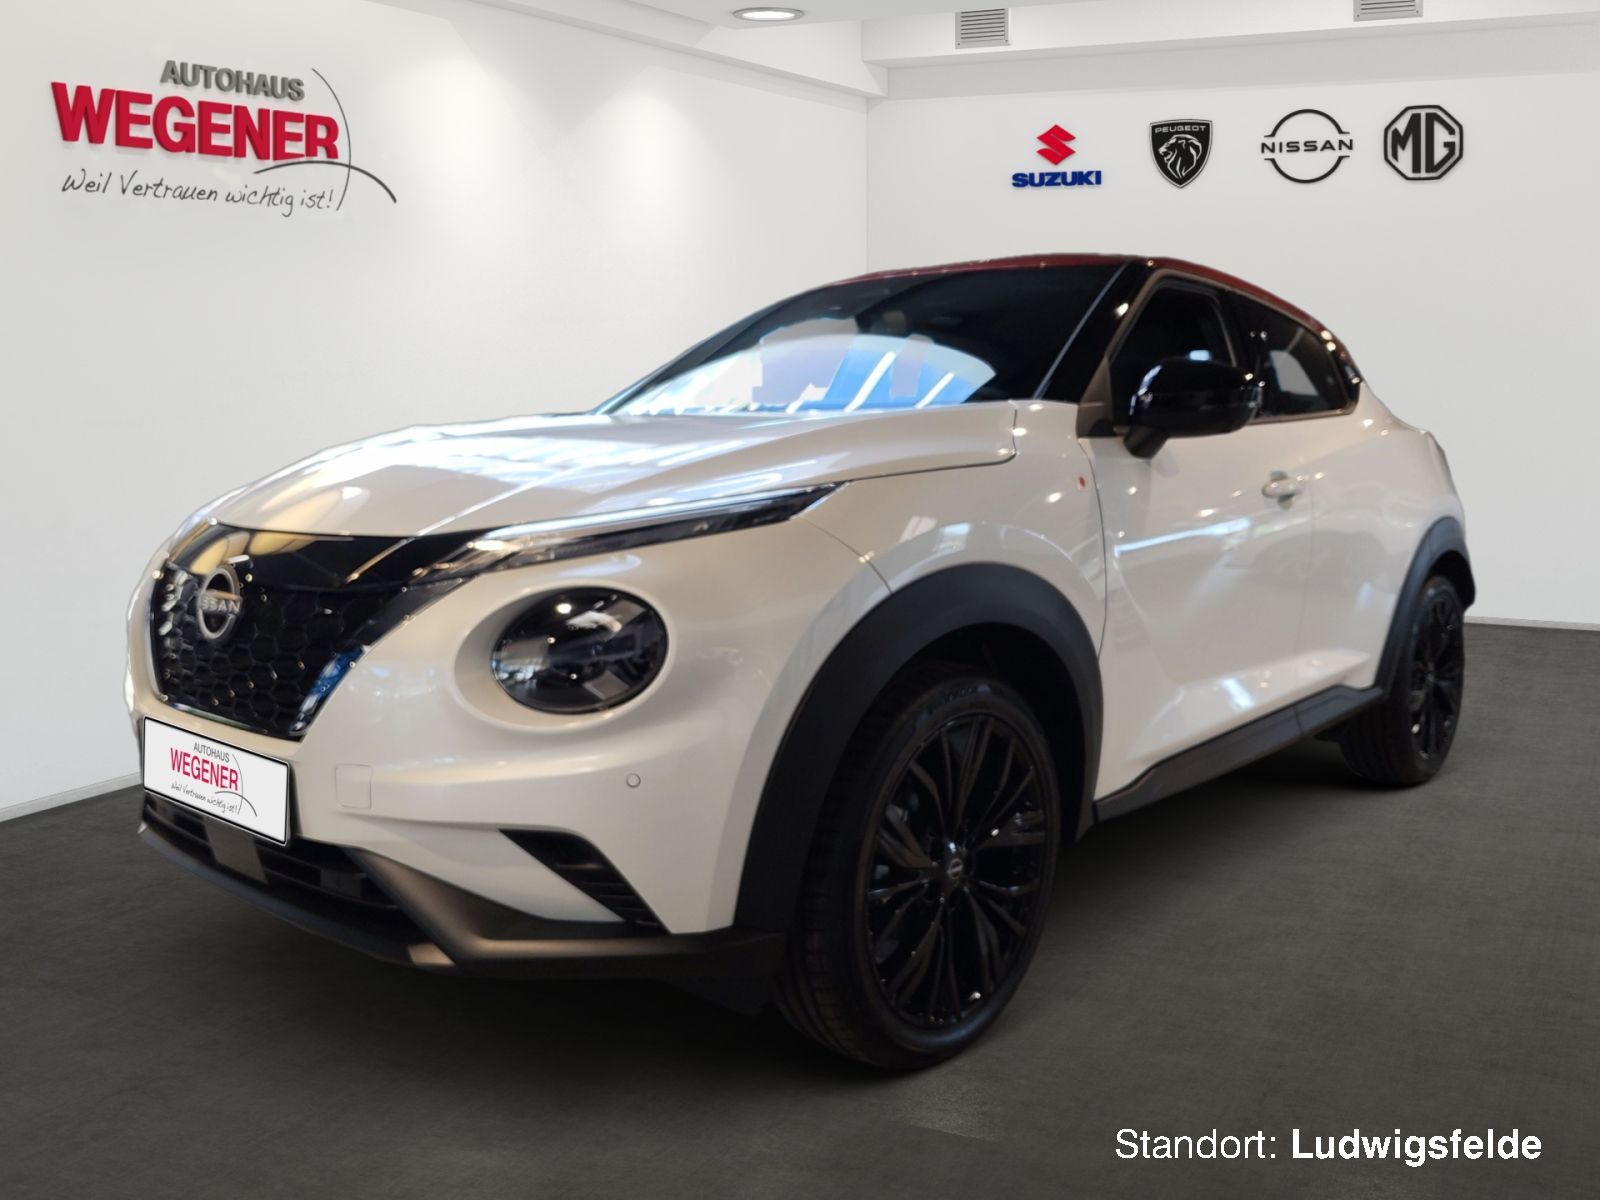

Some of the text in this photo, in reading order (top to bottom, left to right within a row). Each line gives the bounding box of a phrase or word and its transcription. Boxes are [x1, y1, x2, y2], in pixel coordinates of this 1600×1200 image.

[159, 60, 305, 102] AUTOHAUS
[51, 81, 340, 161] WEGENER
[1154, 125, 1206, 134] PEUGEOT
[1261, 139, 1353, 154] NISSAN
[1391, 112, 1456, 173] MG
[61, 168, 334, 218] Weil Vertrauen wichtig ist!
[1011, 170, 1102, 188] SUZUKI
[170, 747, 239, 791] WEGENER
[194, 742, 230, 763] AUTOHAUS
